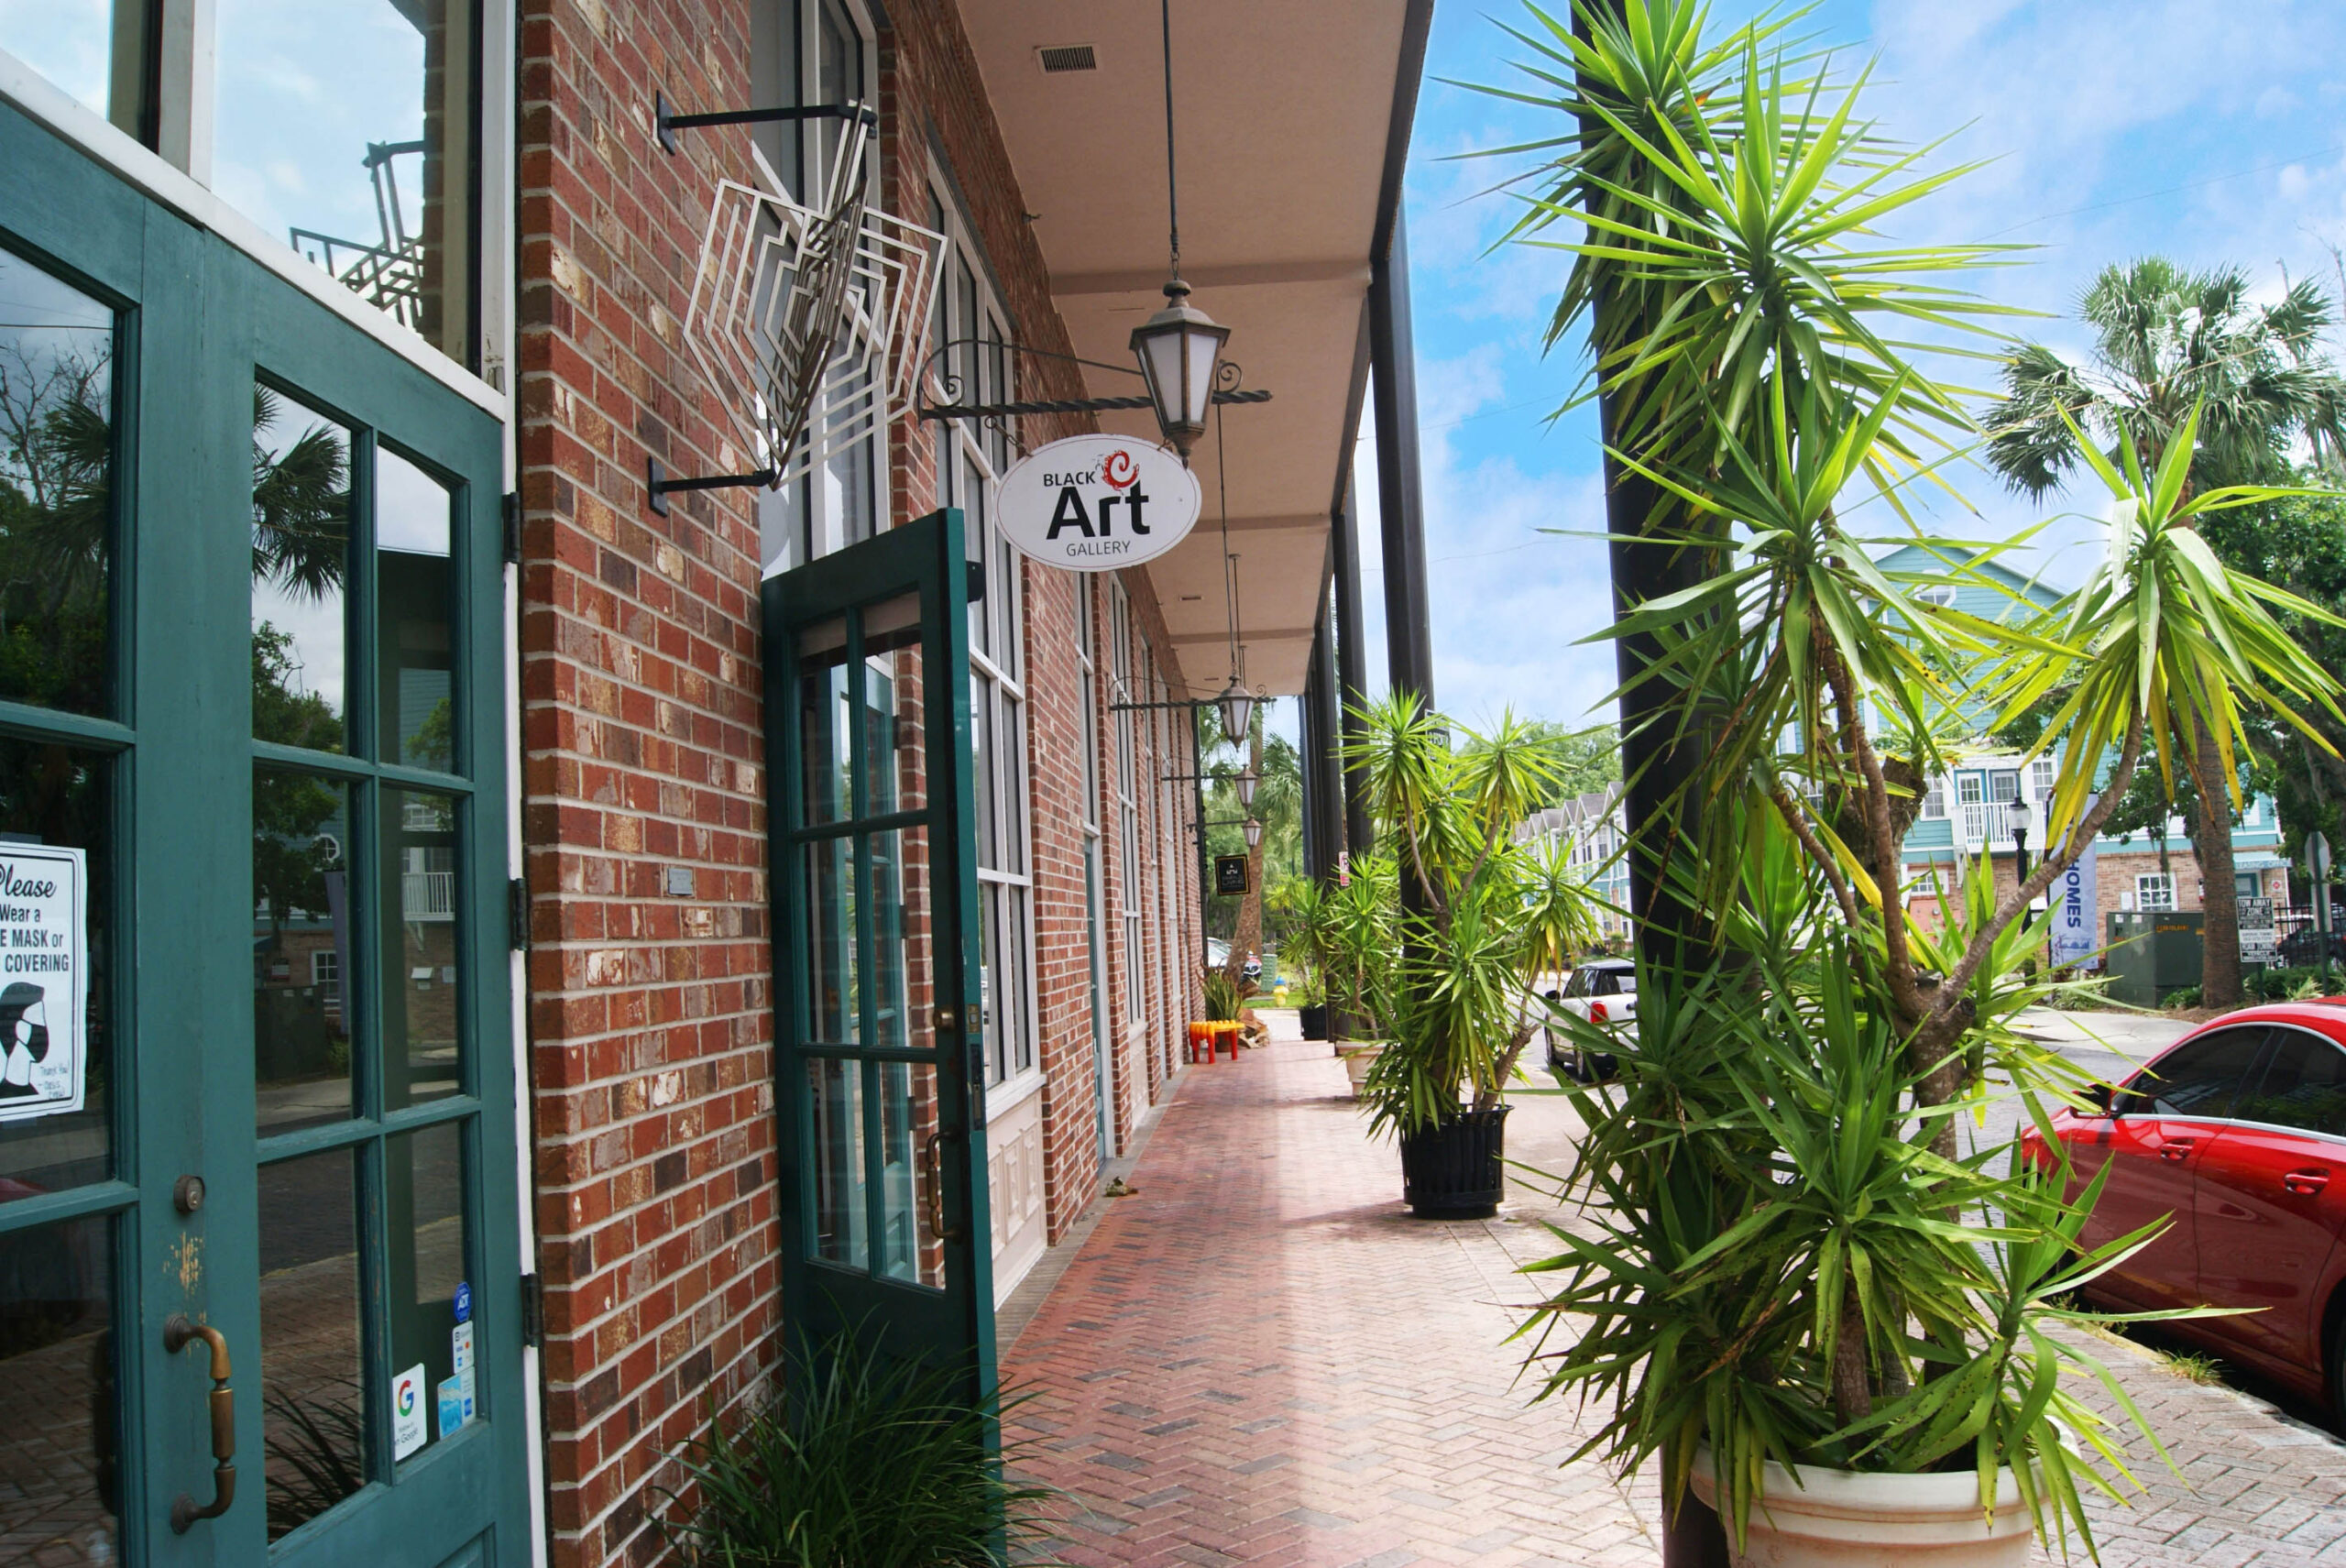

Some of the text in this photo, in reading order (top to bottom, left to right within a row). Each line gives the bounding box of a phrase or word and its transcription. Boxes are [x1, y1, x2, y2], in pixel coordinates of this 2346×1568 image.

[1043, 471, 1096, 487] BLACK
[1046, 480, 1151, 540] Art
[1066, 541, 1131, 556] GALLERY
[0, 904, 41, 923] Wear a
[12, 929, 49, 948] MASK
[52, 933, 63, 948] or
[5, 954, 69, 972] COVERING
